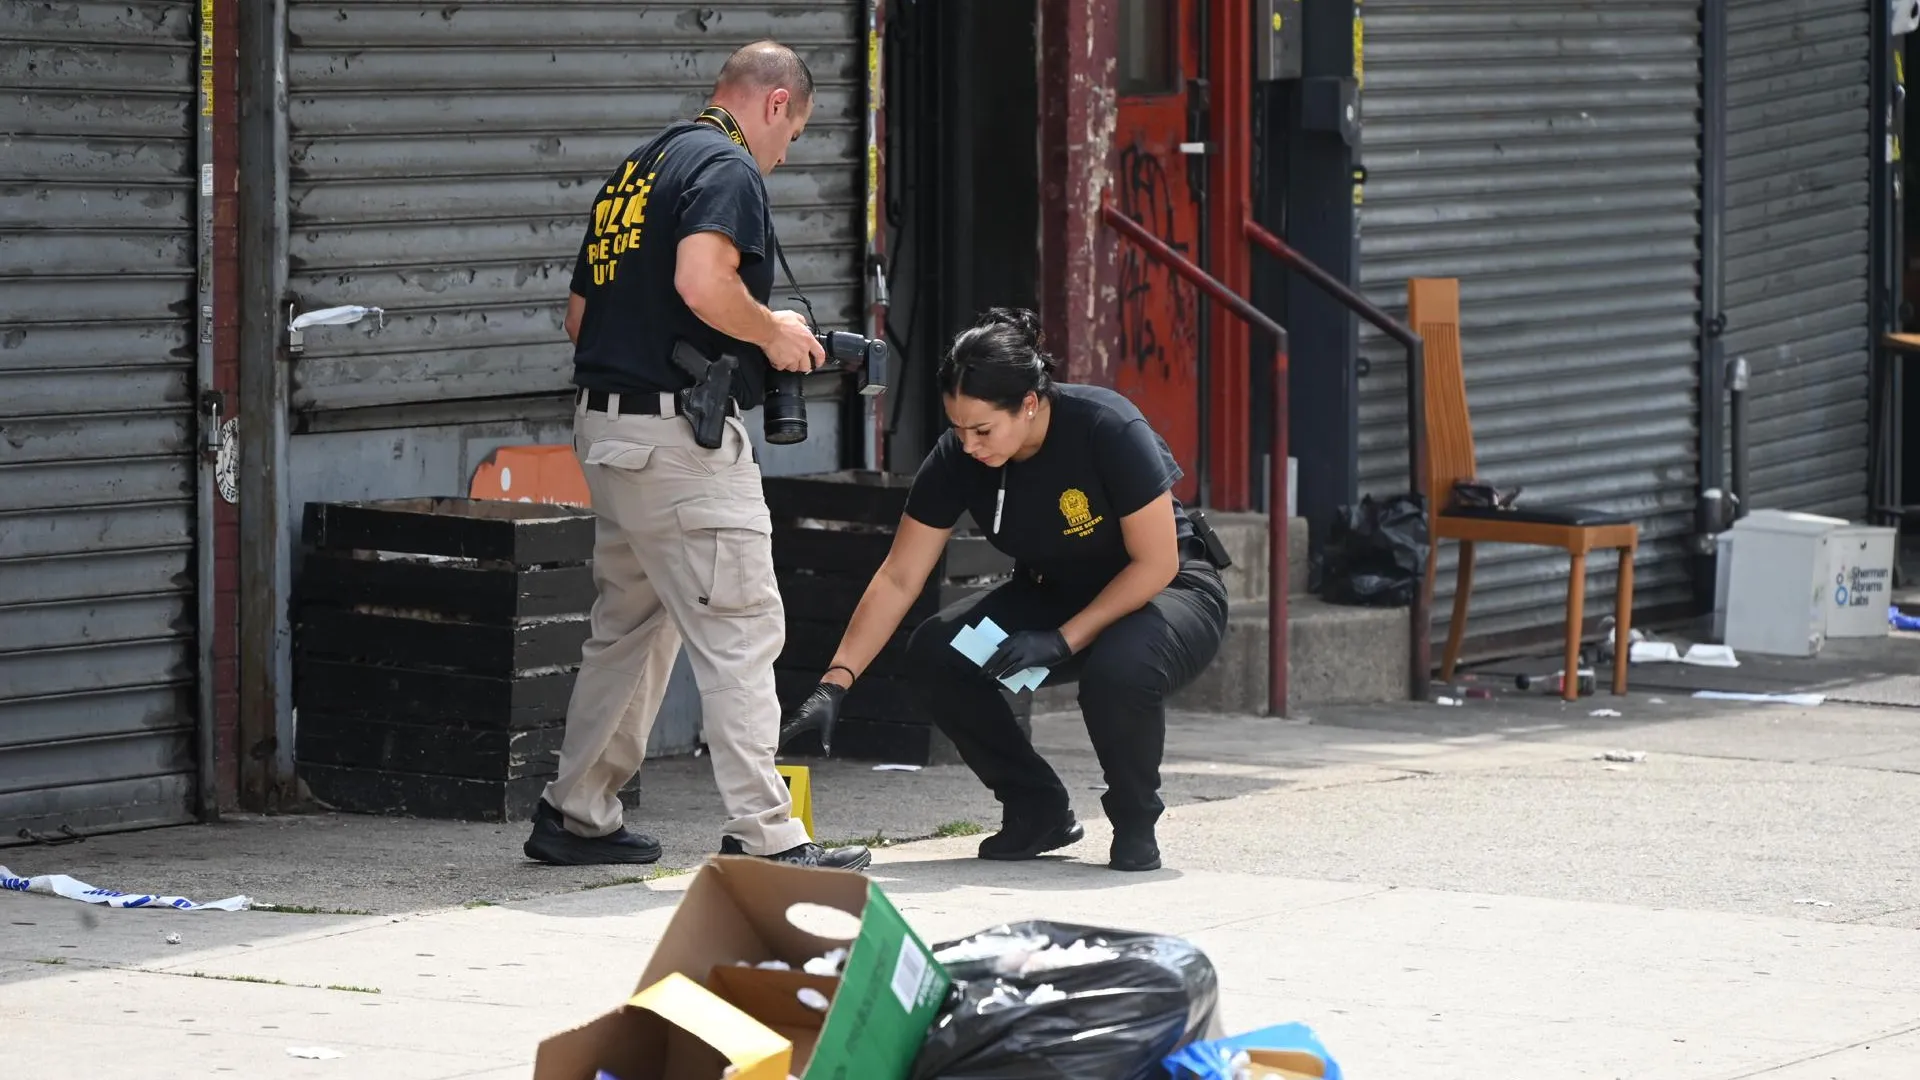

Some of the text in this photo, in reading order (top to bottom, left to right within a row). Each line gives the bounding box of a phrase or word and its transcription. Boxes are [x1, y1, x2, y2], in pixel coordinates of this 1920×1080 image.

[1063, 515, 1103, 535] CRIME SCENE
[1079, 527, 1094, 537] UNIT
[1851, 566, 1889, 578] Sherman
[1851, 580, 1882, 592] Abrams
[1850, 594, 1869, 606] Labs
